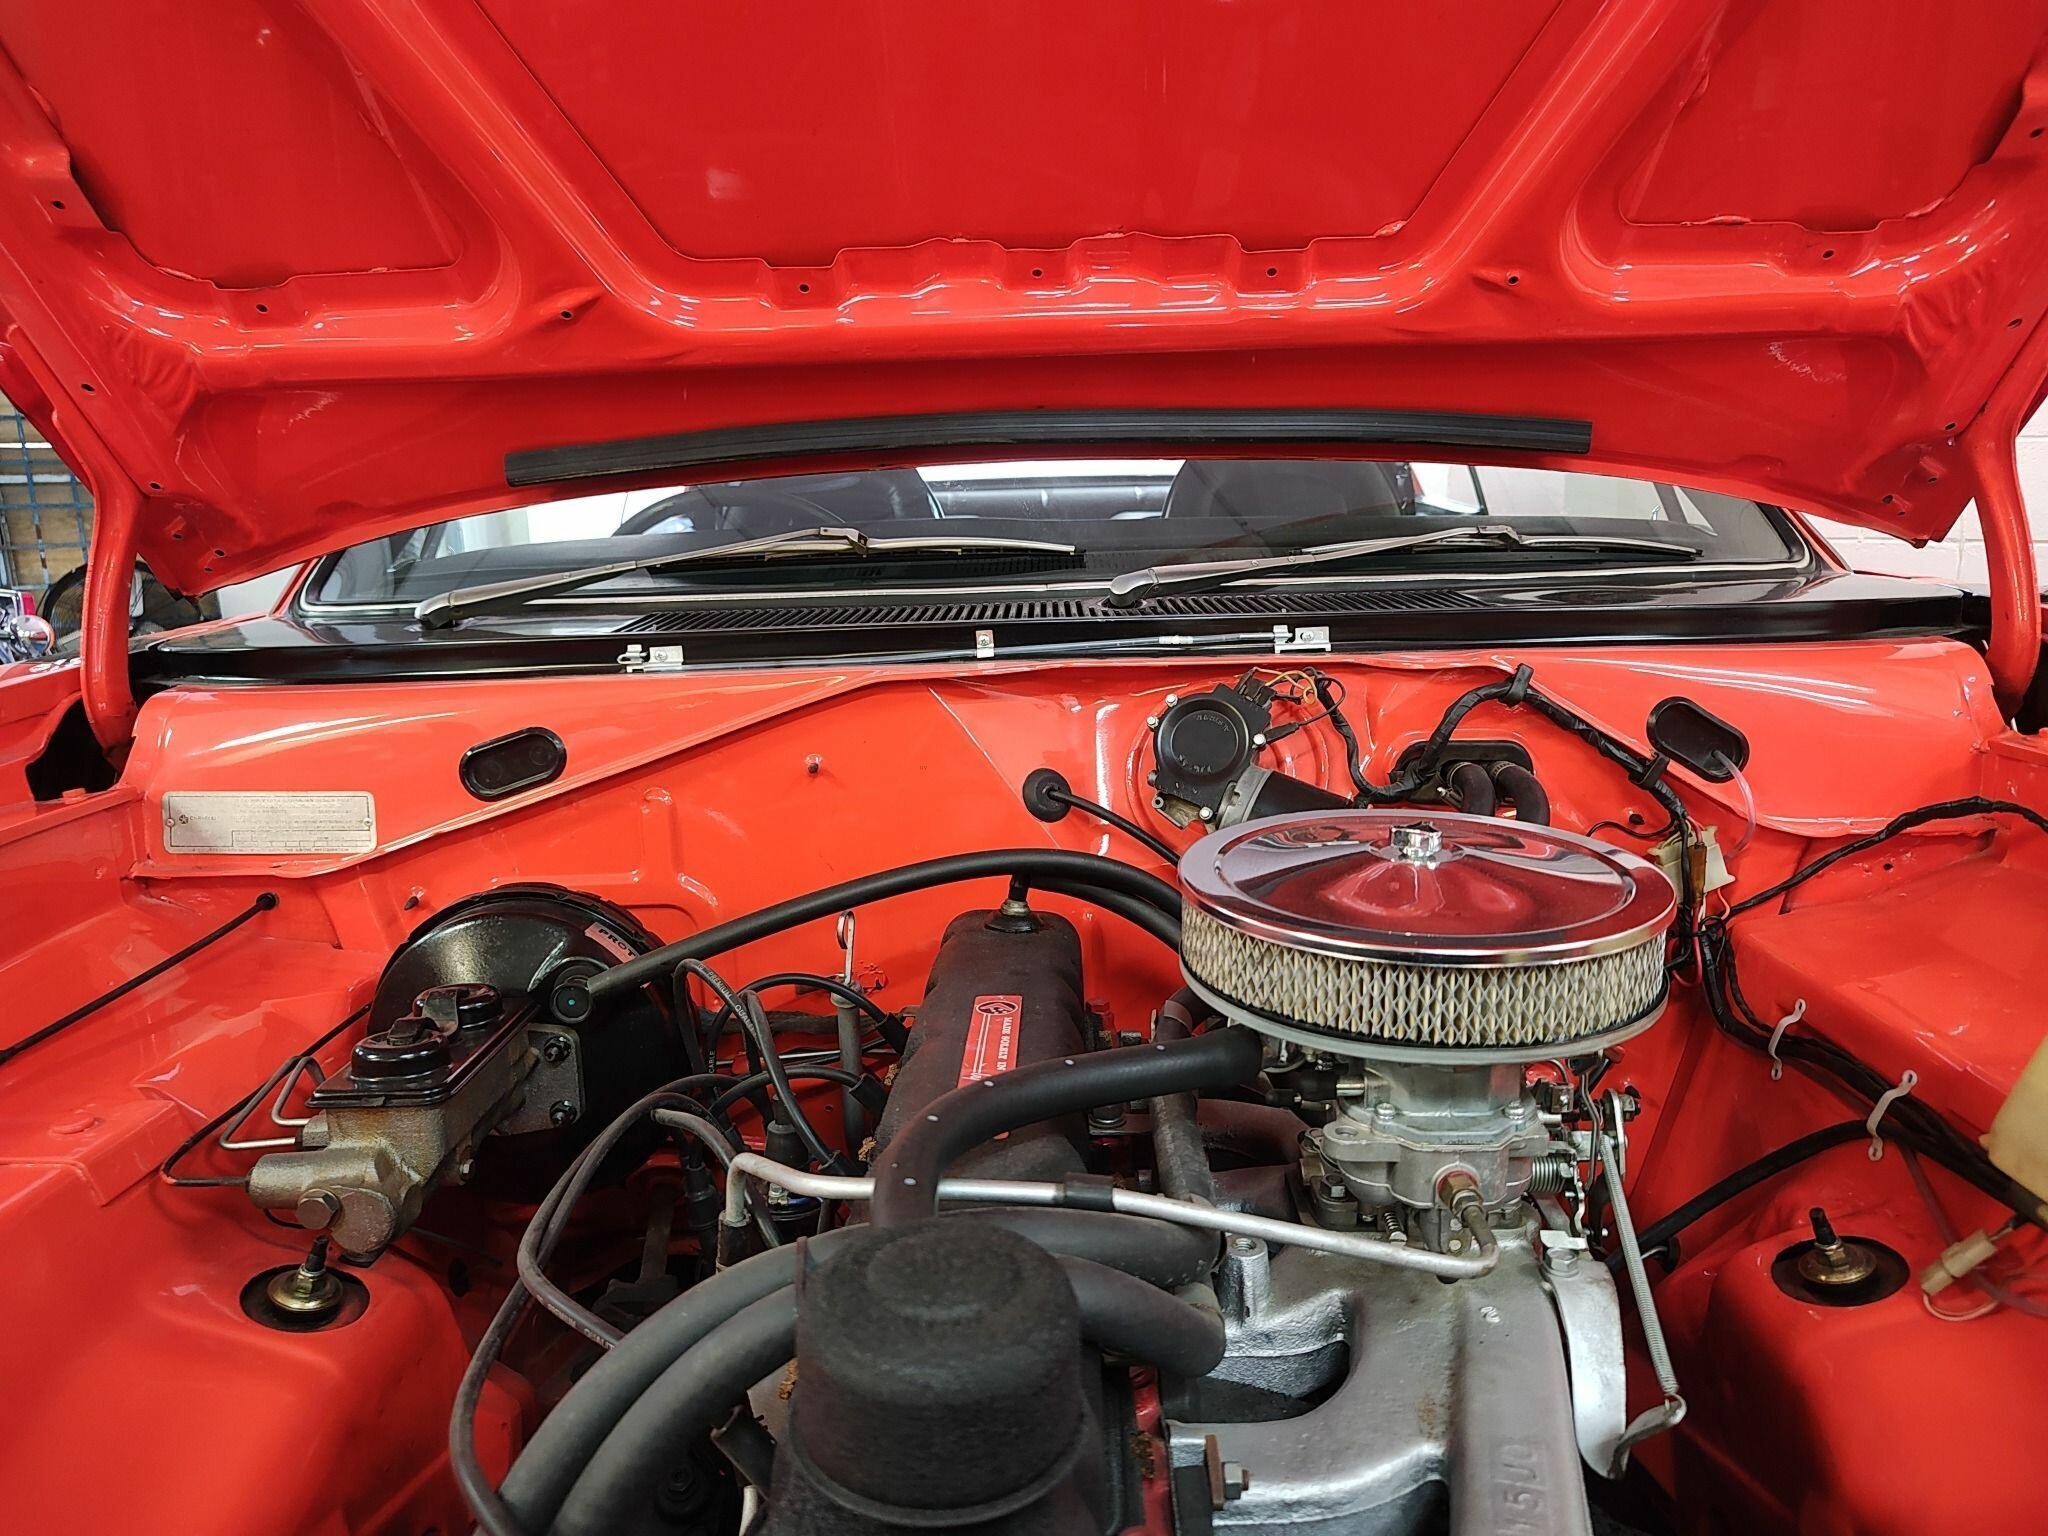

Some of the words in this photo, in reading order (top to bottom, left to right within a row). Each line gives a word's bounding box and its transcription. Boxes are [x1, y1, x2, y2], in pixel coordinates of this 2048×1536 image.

[707, 970, 733, 1001] PREMIUM
[1002, 1016, 1013, 1035] MADE
[998, 1035, 1010, 1060] SOLELY
[708, 1050, 716, 1074] CABLE
[996, 1061, 1007, 1071] IN
